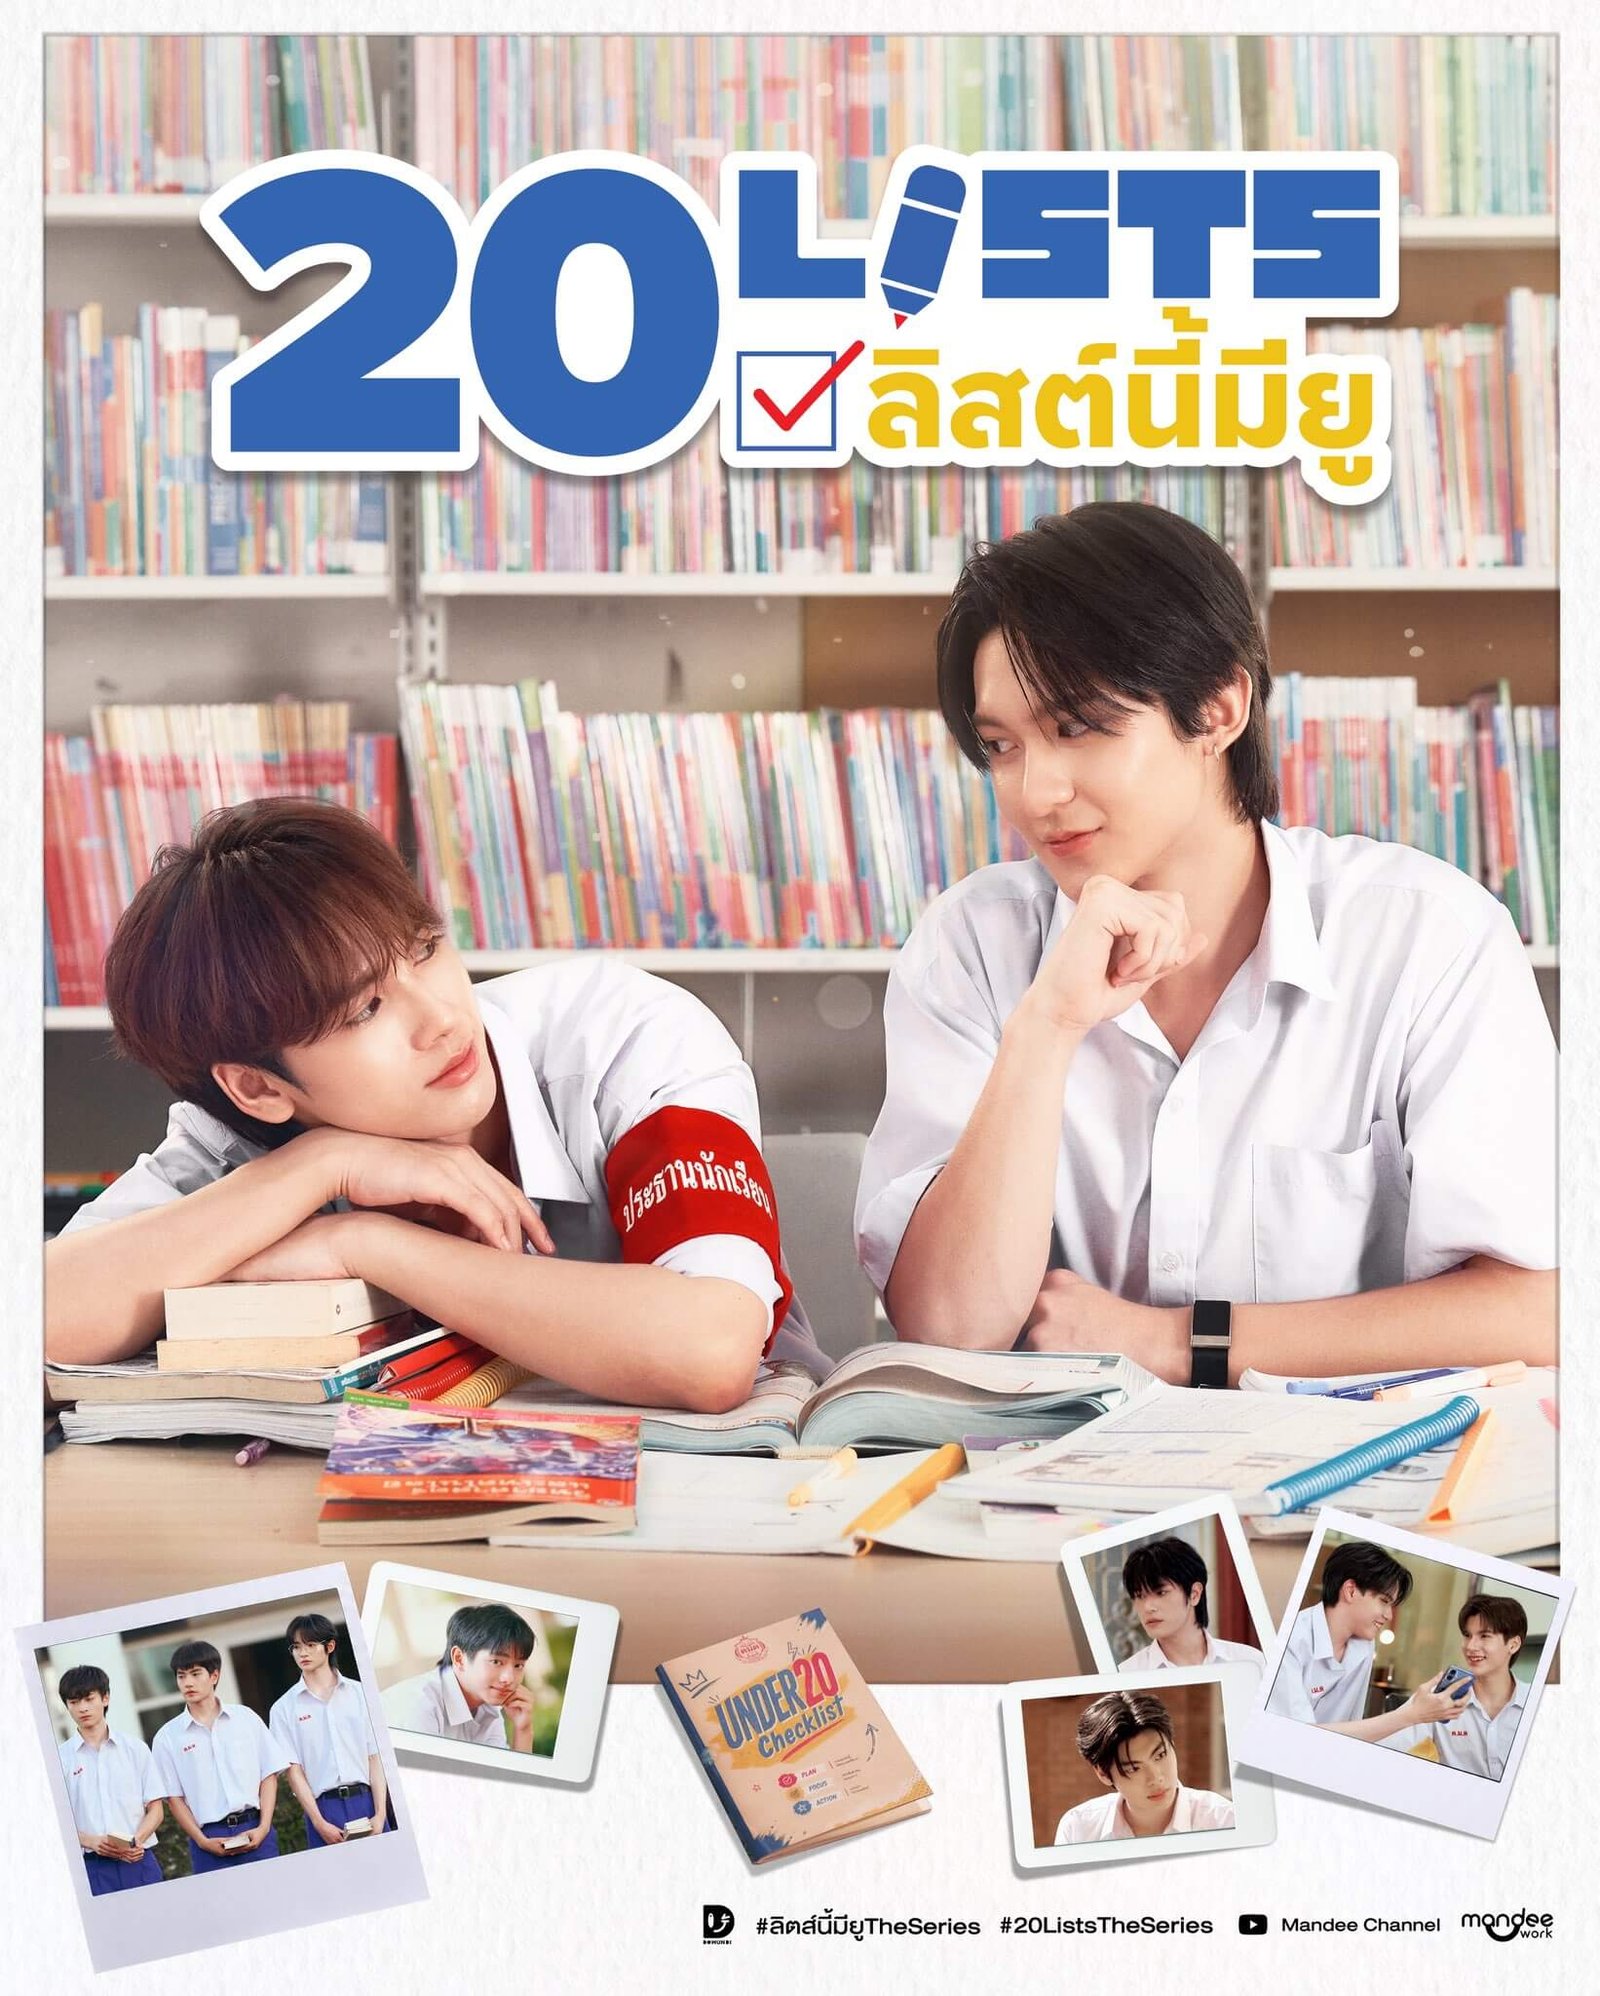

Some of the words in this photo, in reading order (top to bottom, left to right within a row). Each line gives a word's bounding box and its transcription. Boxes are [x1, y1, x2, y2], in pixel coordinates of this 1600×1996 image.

[623, 1151, 773, 1232] ประธานนักเรียน
[758, 1695, 844, 1758] Checklist
[801, 1768, 817, 1778] PLAN
[808, 1780, 828, 1792] FOCUS
[816, 1794, 837, 1806] ACTION
